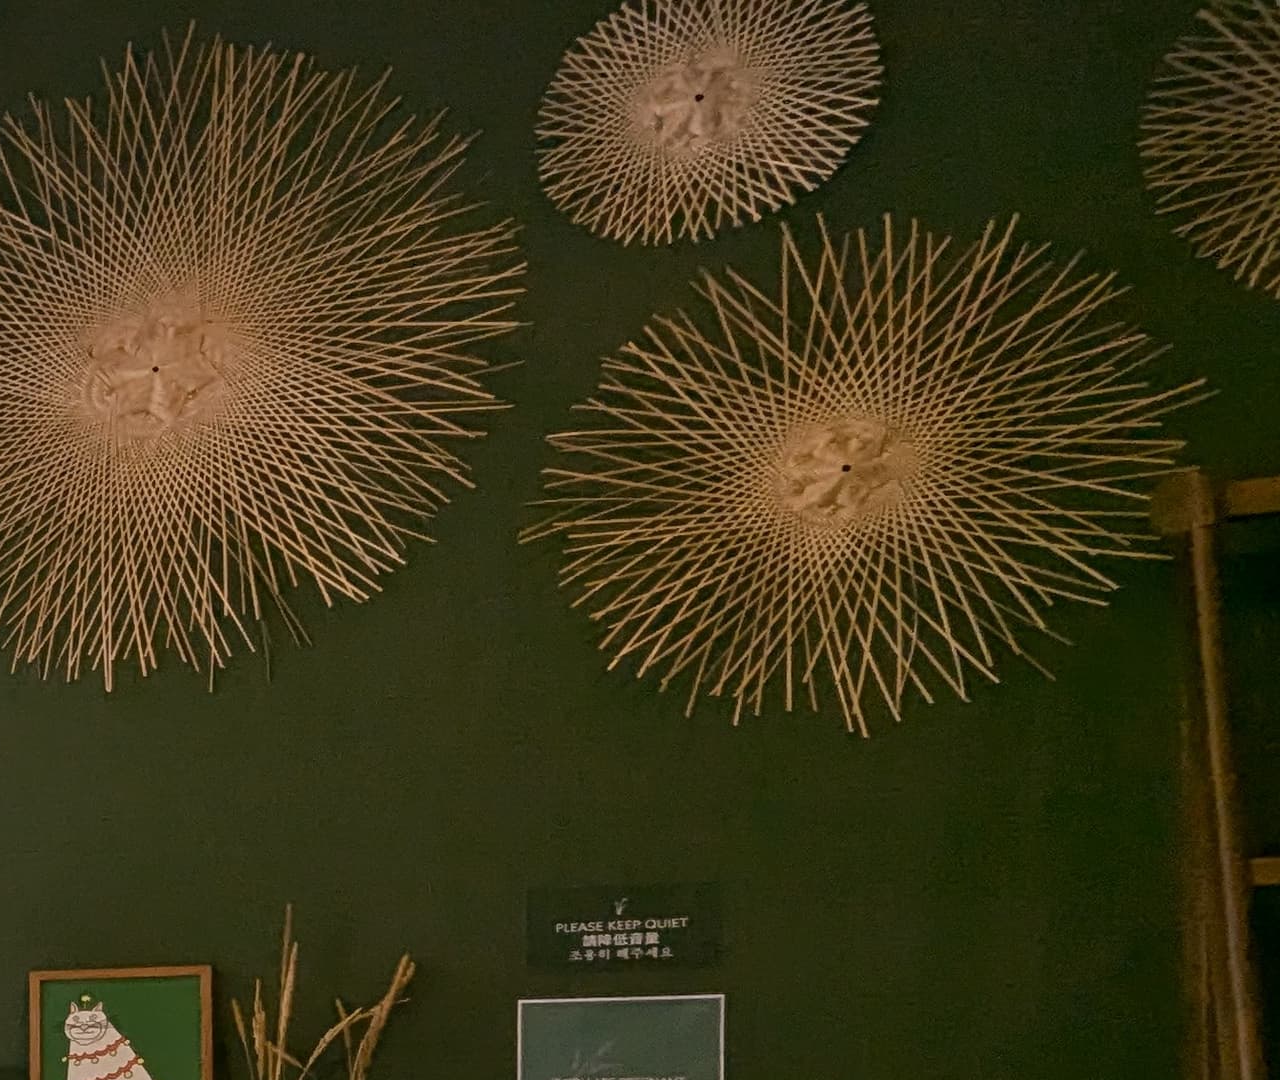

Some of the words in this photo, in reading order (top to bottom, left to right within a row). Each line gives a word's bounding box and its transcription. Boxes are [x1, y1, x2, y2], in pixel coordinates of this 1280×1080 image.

[556, 921, 604, 933] PLEASE
[608, 920, 641, 931] KEEP
[645, 917, 689, 930] QUIET
